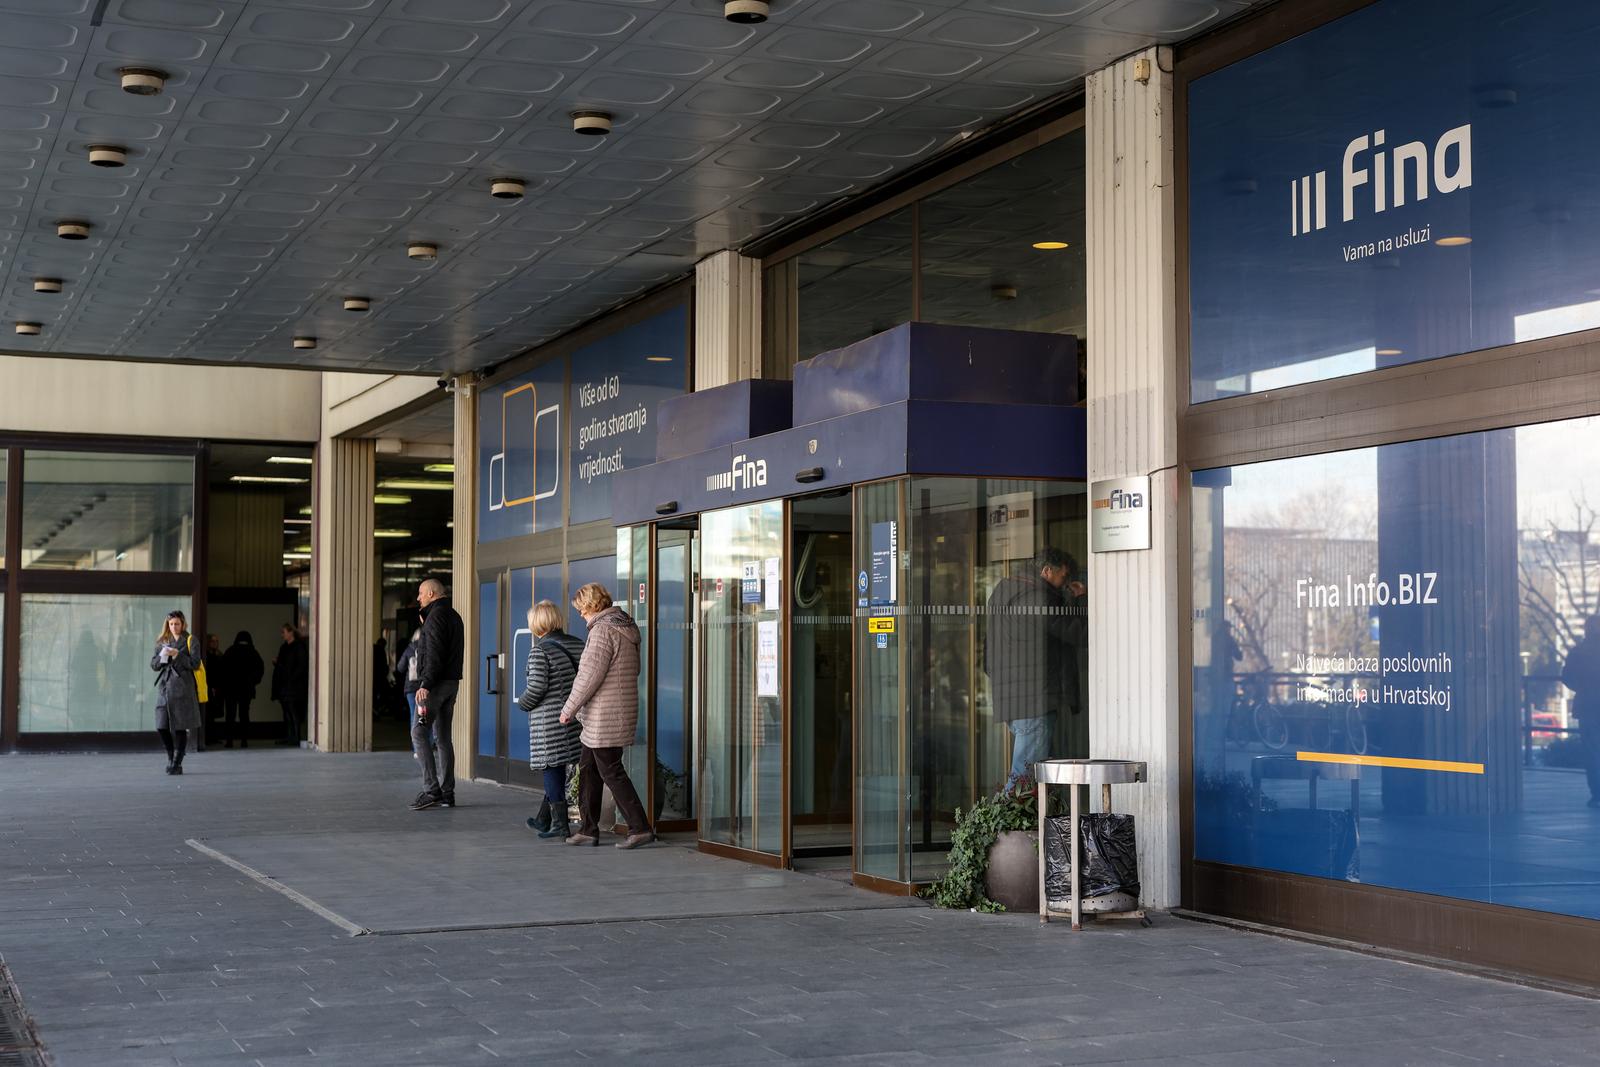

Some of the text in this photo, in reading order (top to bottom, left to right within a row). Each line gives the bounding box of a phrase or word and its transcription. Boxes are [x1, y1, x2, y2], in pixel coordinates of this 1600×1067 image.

[1342, 223, 1431, 262] Vama na usluzi
[579, 375, 620, 408] Više od 60
[579, 403, 647, 450] godina stvaranja
[579, 447, 624, 484] vrijednosti.
[1296, 572, 1438, 608] Fina Info.BIZ
[1296, 652, 1452, 677] Najveća baza poslovnih
[1296, 682, 1451, 711] informacija u Hrvatskoj
